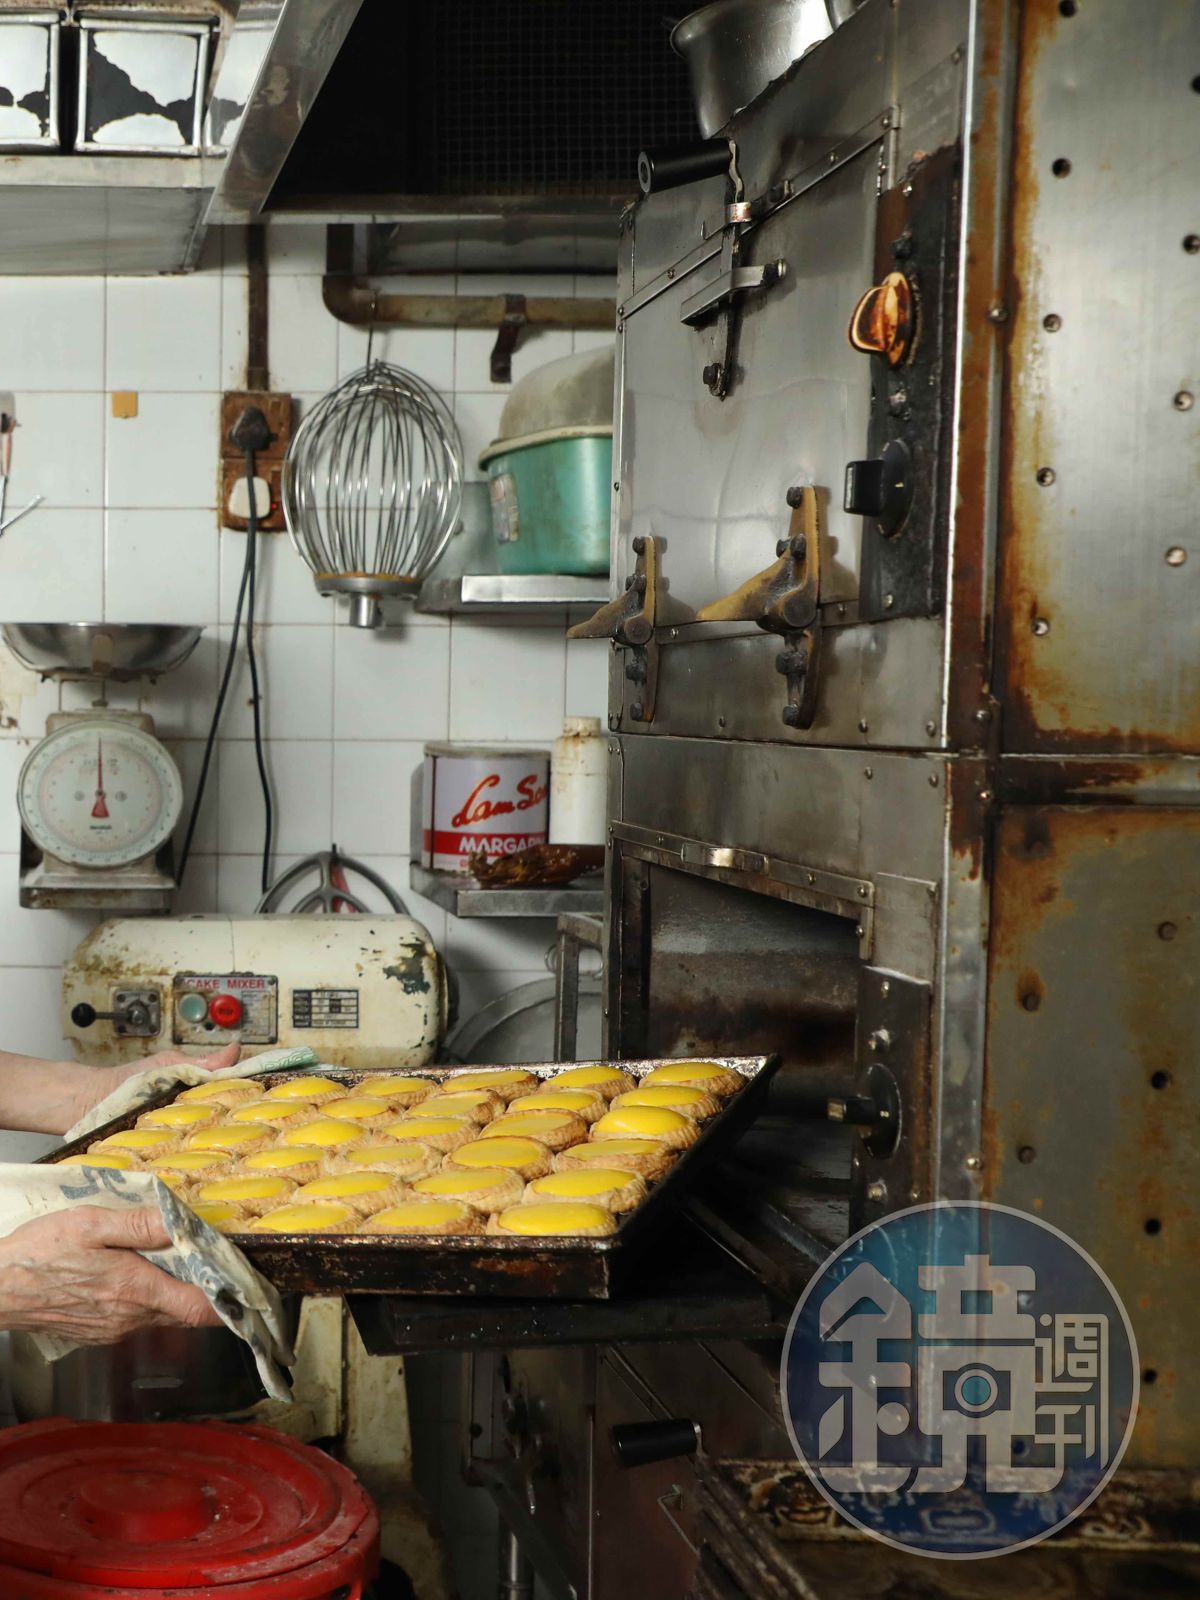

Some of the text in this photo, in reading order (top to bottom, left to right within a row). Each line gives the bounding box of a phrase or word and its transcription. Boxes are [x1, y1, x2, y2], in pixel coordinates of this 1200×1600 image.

[451, 774, 515, 828] Lam
[187, 979, 265, 989] CAKE MIXER
